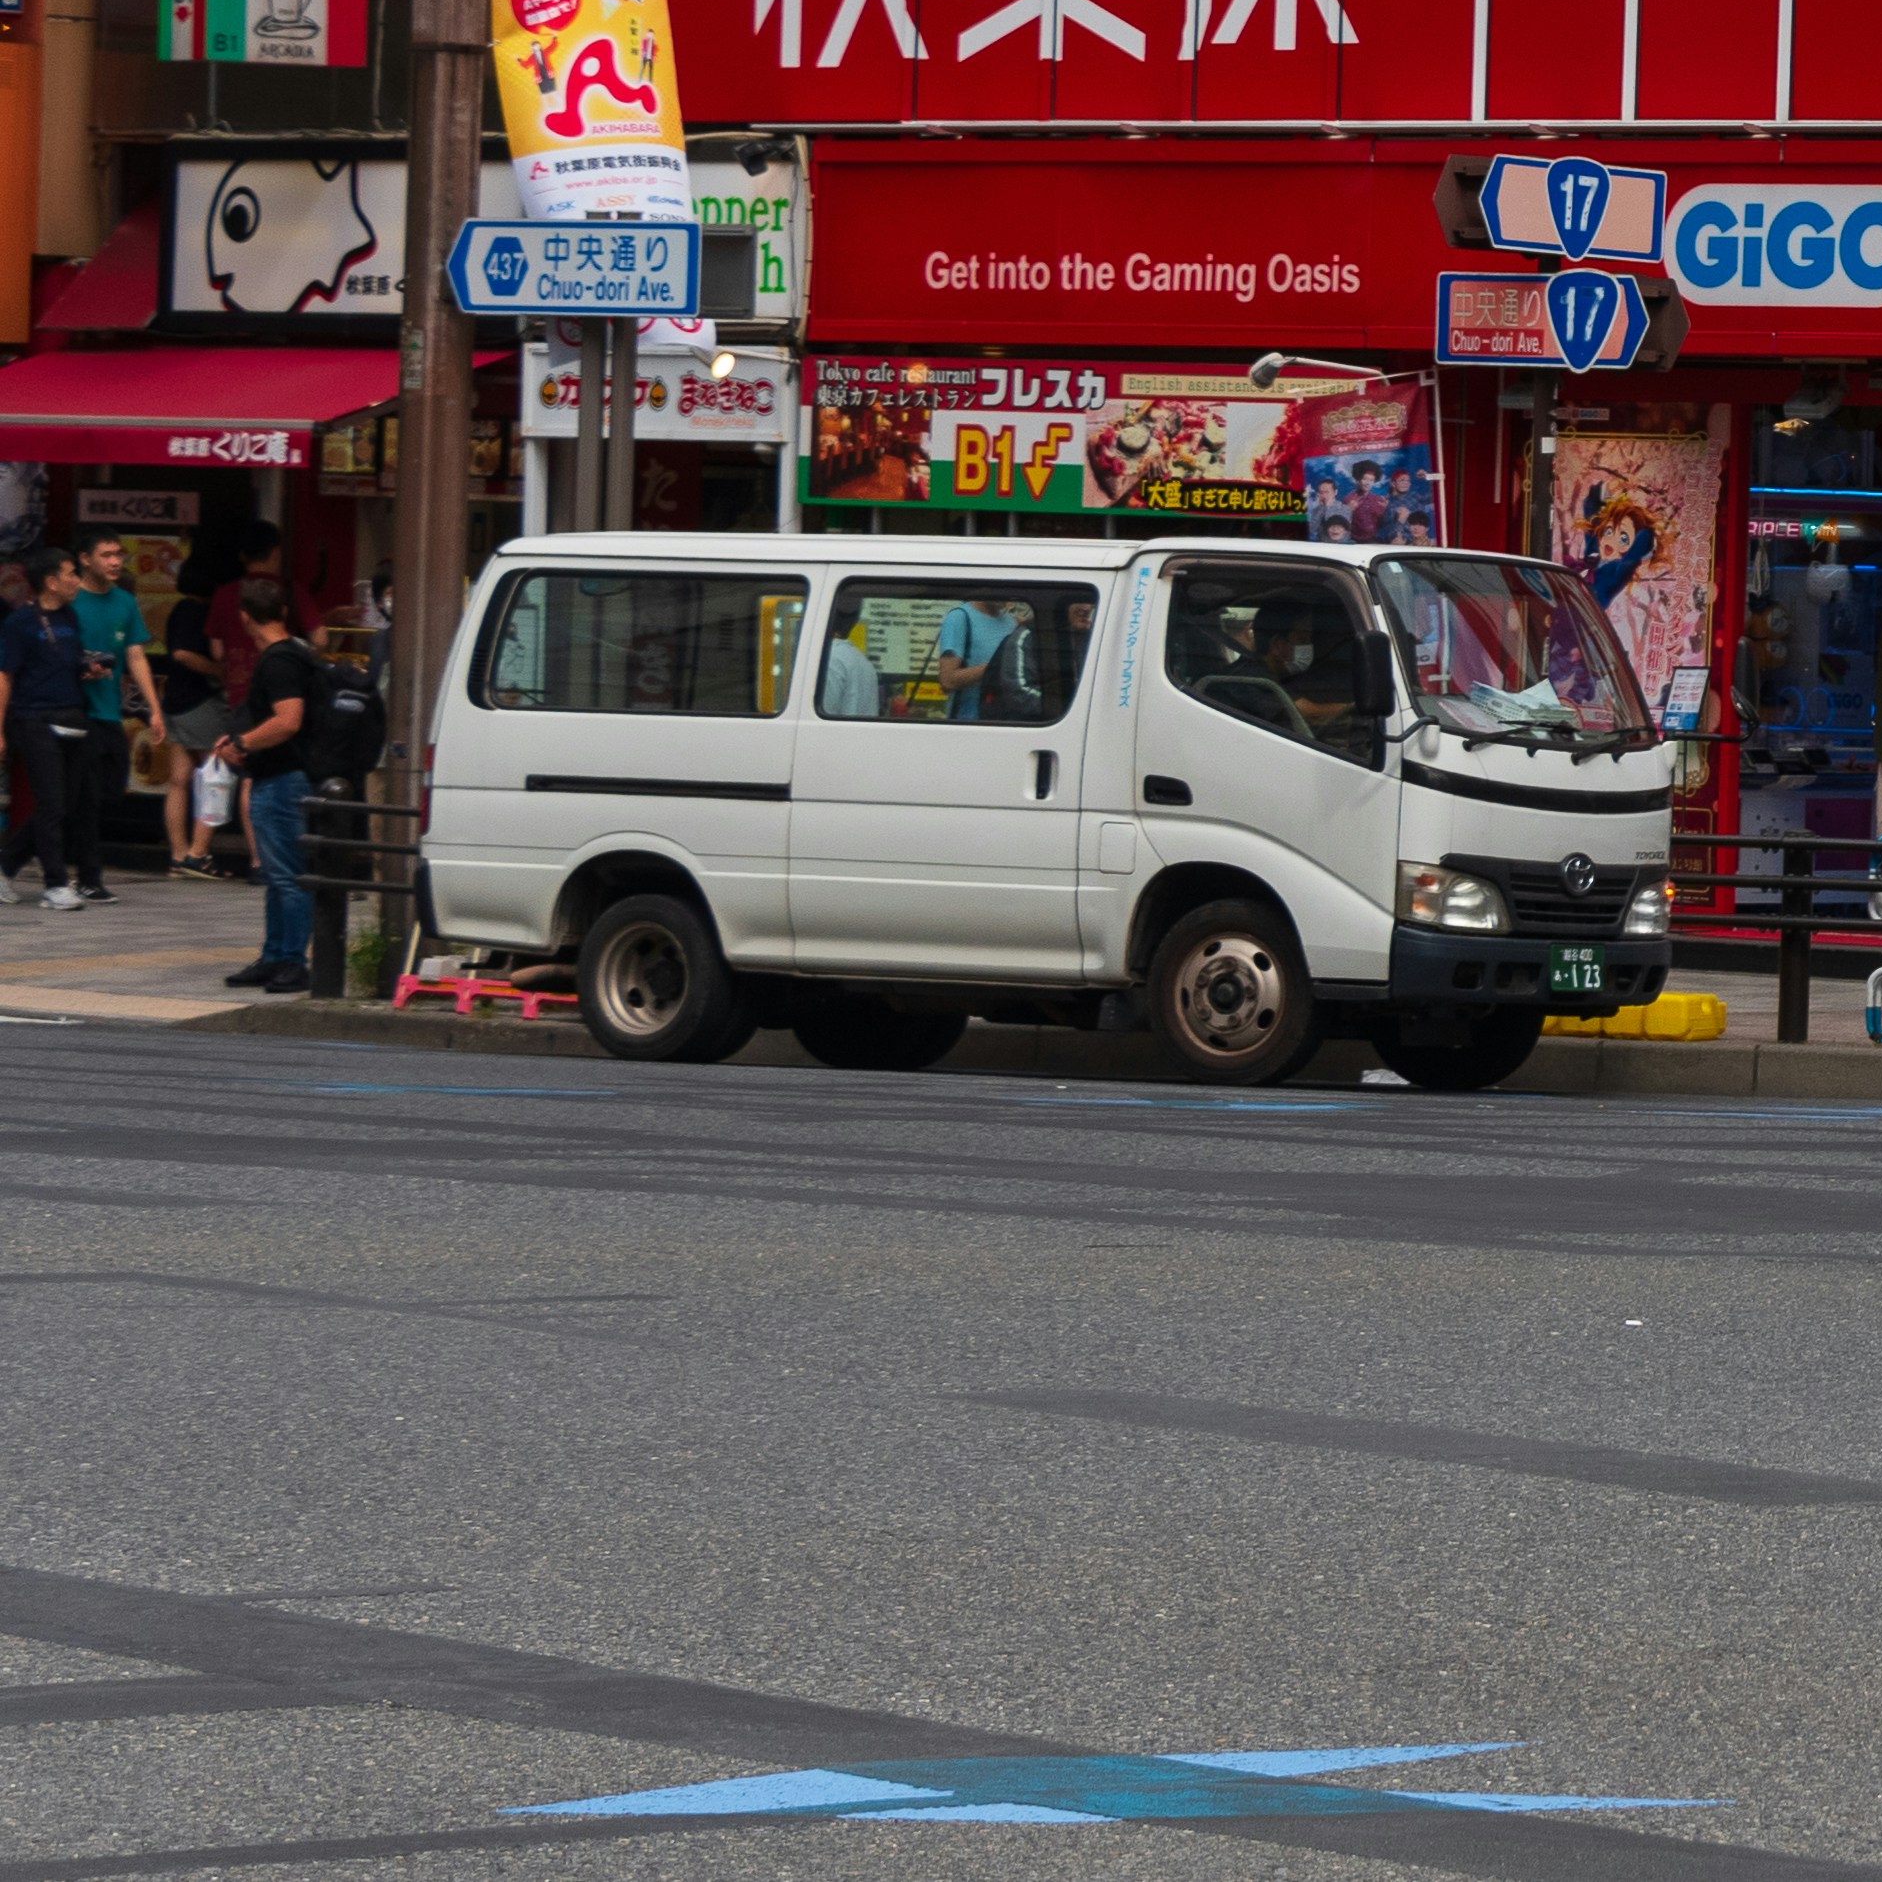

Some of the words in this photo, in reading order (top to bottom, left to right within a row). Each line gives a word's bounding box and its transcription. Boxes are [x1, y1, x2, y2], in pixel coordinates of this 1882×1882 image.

[1560, 174, 1600, 232] 17
[486, 252, 525, 281] 437
[544, 233, 669, 273] 中央通り
[537, 274, 631, 303] Chuo-dori
[636, 275, 675, 302] Ave.
[925, 251, 980, 290] Get
[988, 252, 1050, 290] into
[1061, 253, 1115, 291] the
[1125, 253, 1257, 303] Gaming
[1267, 253, 1361, 293] Oasis
[1453, 288, 1543, 328] 中央通り
[1561, 286, 1606, 342] 17
[1452, 331, 1513, 352] Chuo-dori
[1517, 334, 1543, 354] Ave.
[816, 360, 860, 385] Tokyo
[865, 361, 894, 383] cafe
[901, 366, 976, 385] restaurant
[980, 368, 1106, 410] フレスカ
[1128, 378, 1182, 394] English
[678, 371, 775, 415] まねきねこ
[816, 387, 977, 409] 東京カフェレストラン
[954, 424, 1016, 498] B1
[1140, 480, 1306, 511] 「大盛」すぎて申し訳ないっ
